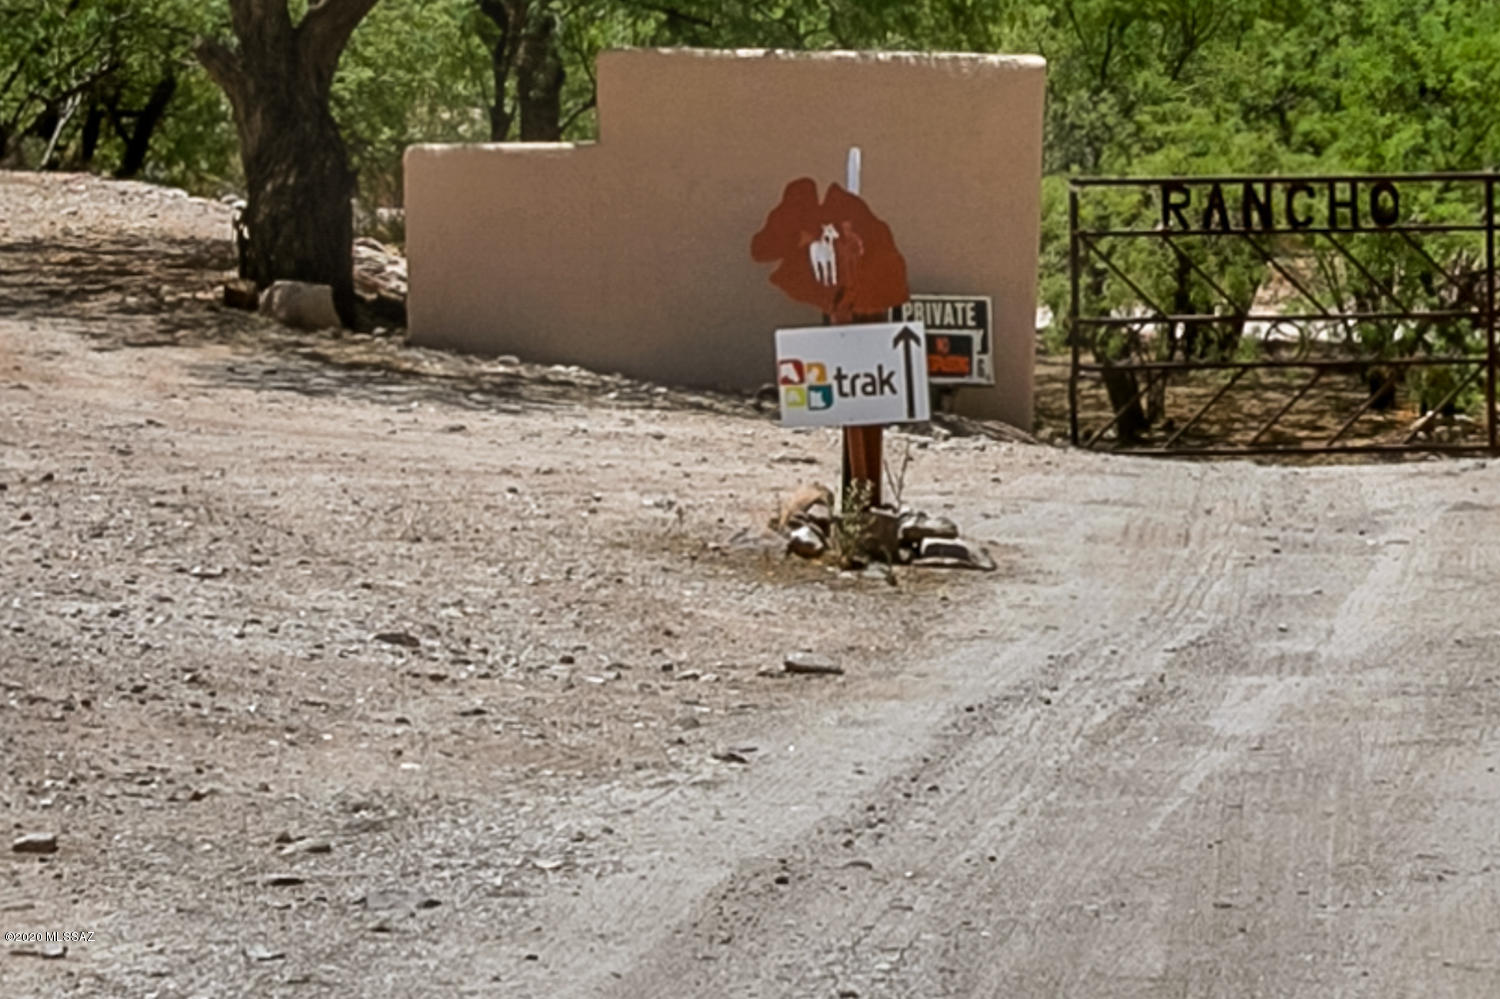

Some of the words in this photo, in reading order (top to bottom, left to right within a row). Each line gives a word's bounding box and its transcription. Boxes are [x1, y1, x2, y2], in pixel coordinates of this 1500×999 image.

[1162, 182, 1399, 231] RANCHO
[902, 302, 977, 327] PRIVATE
[833, 364, 897, 398] trak
